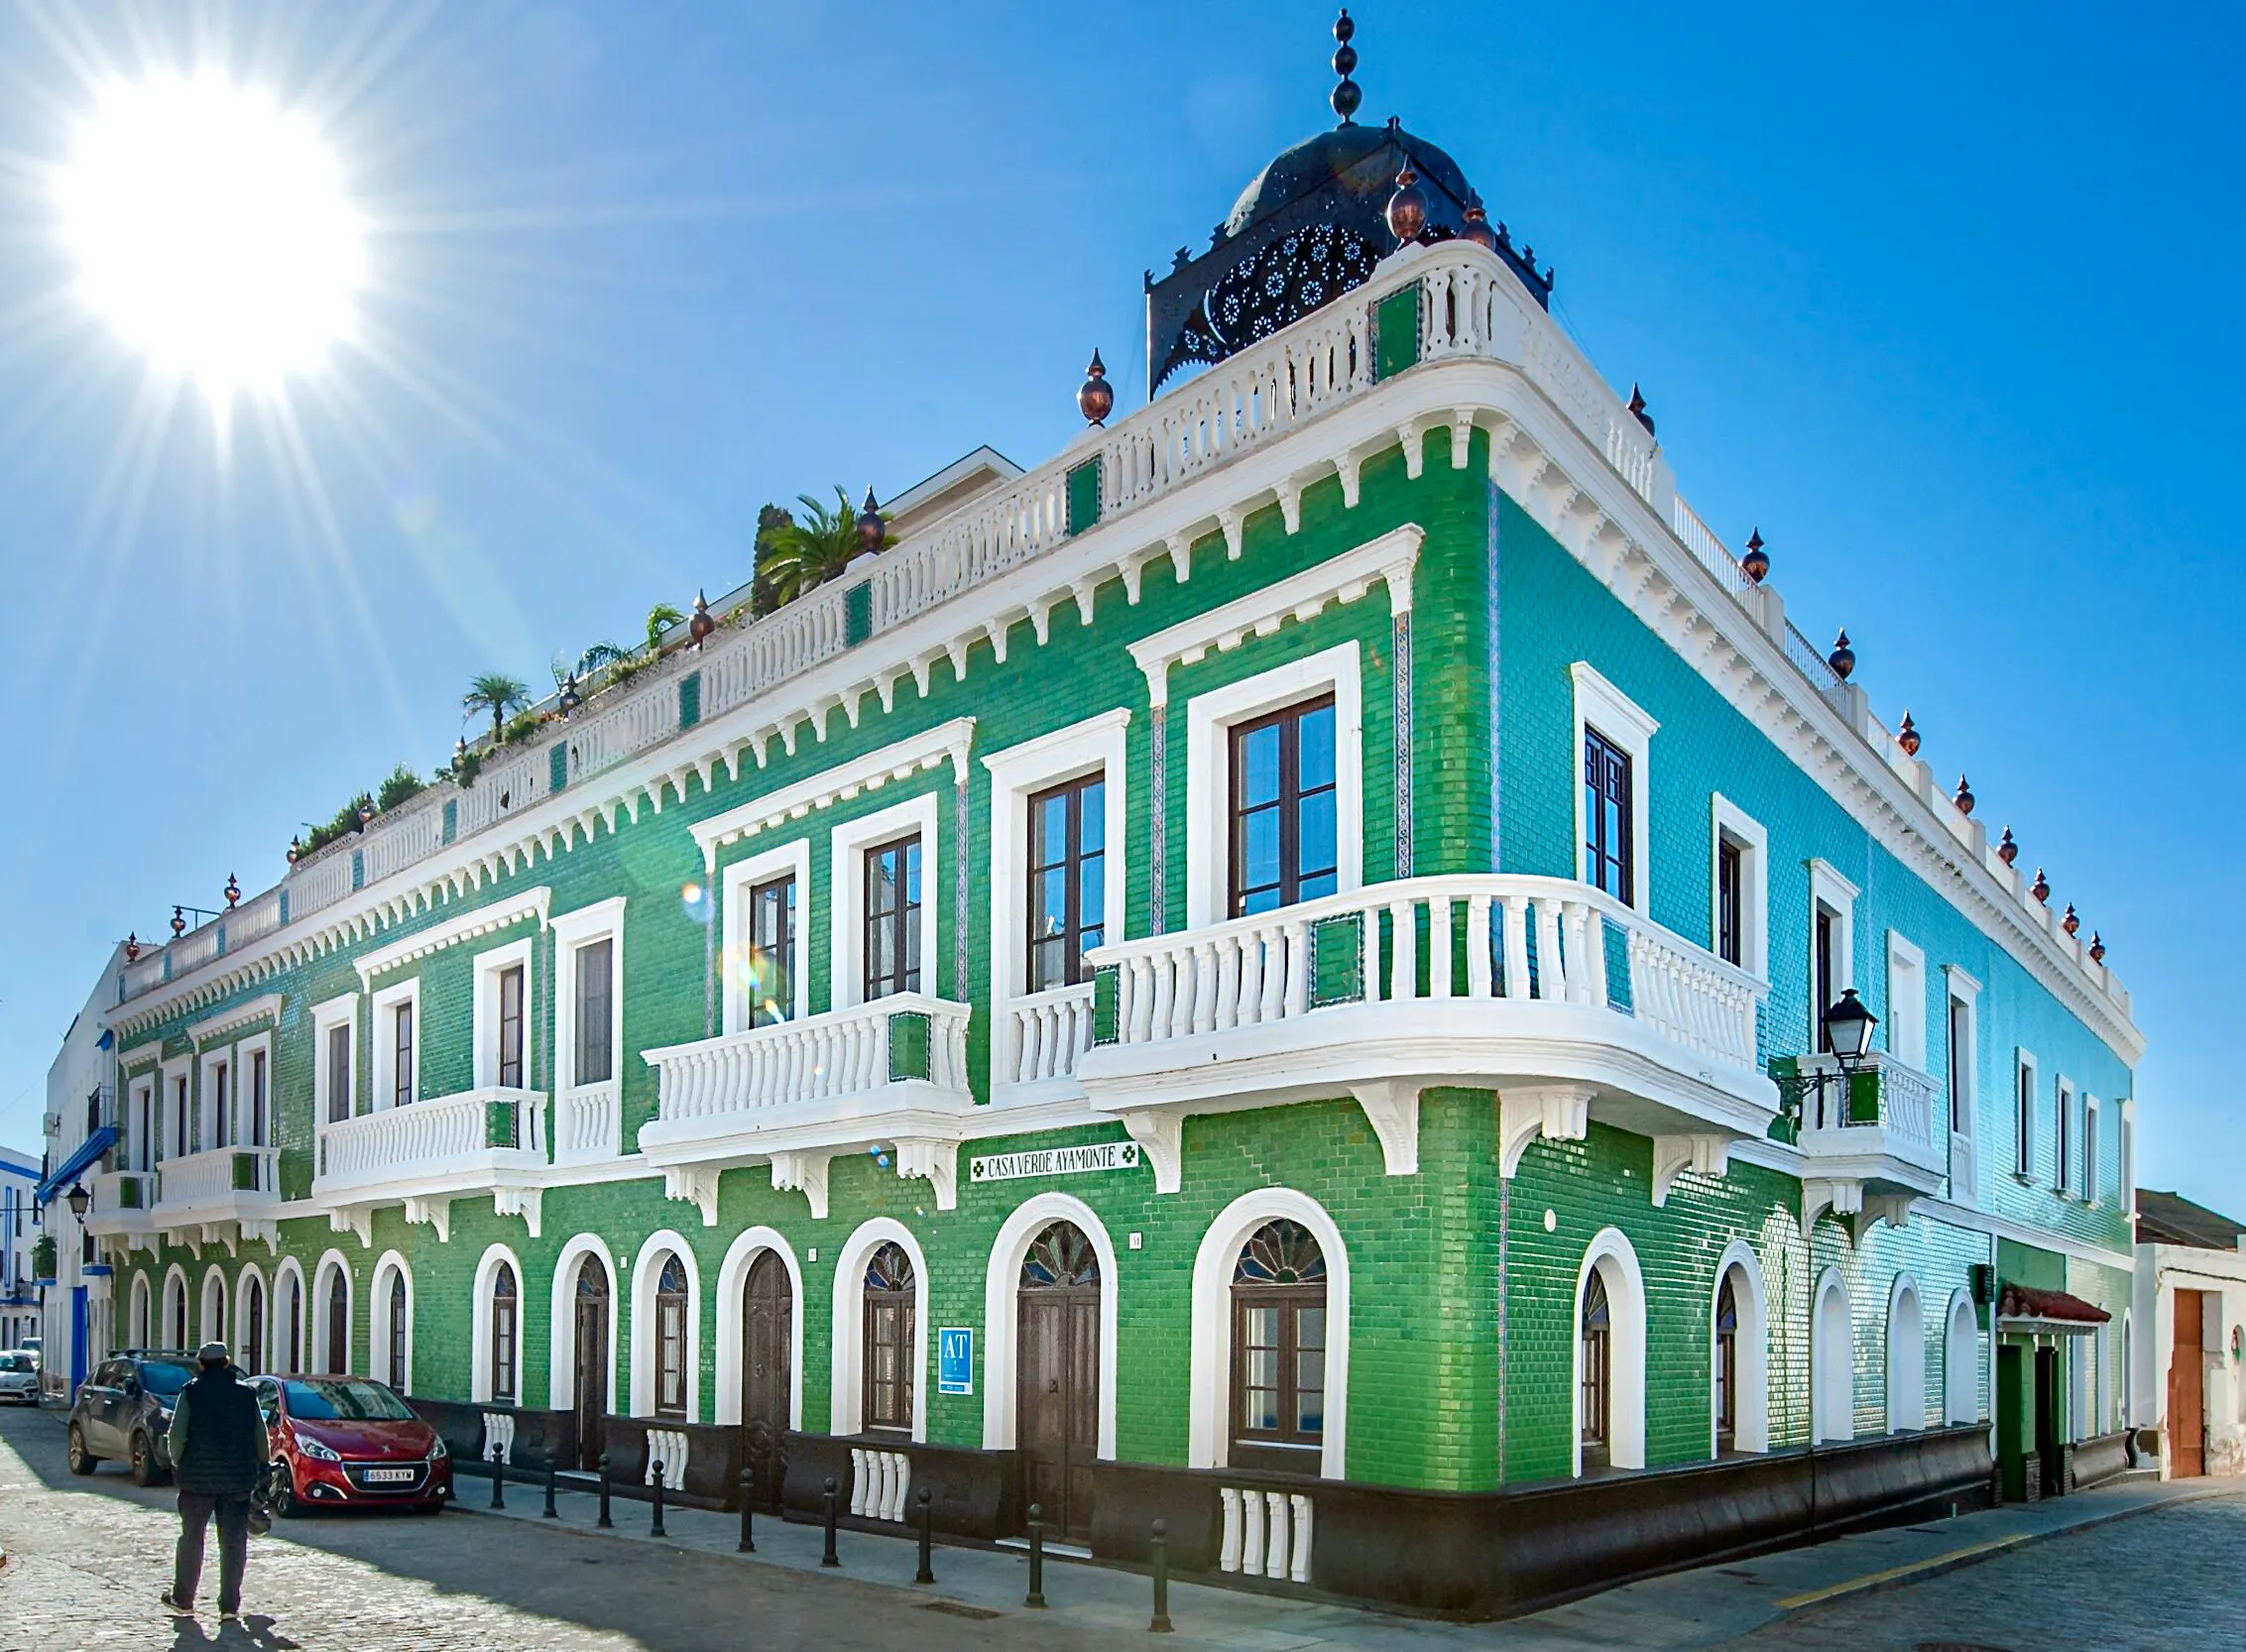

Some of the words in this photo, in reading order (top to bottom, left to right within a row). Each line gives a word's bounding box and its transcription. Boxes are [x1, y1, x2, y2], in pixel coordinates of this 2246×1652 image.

[988, 1157, 1014, 1177] CASA
[1017, 1152, 1052, 1174] VERDE
[1055, 1145, 1116, 1172] AYAMONTE
[944, 1334, 968, 1358] AT
[370, 1471, 393, 1479] 6533
